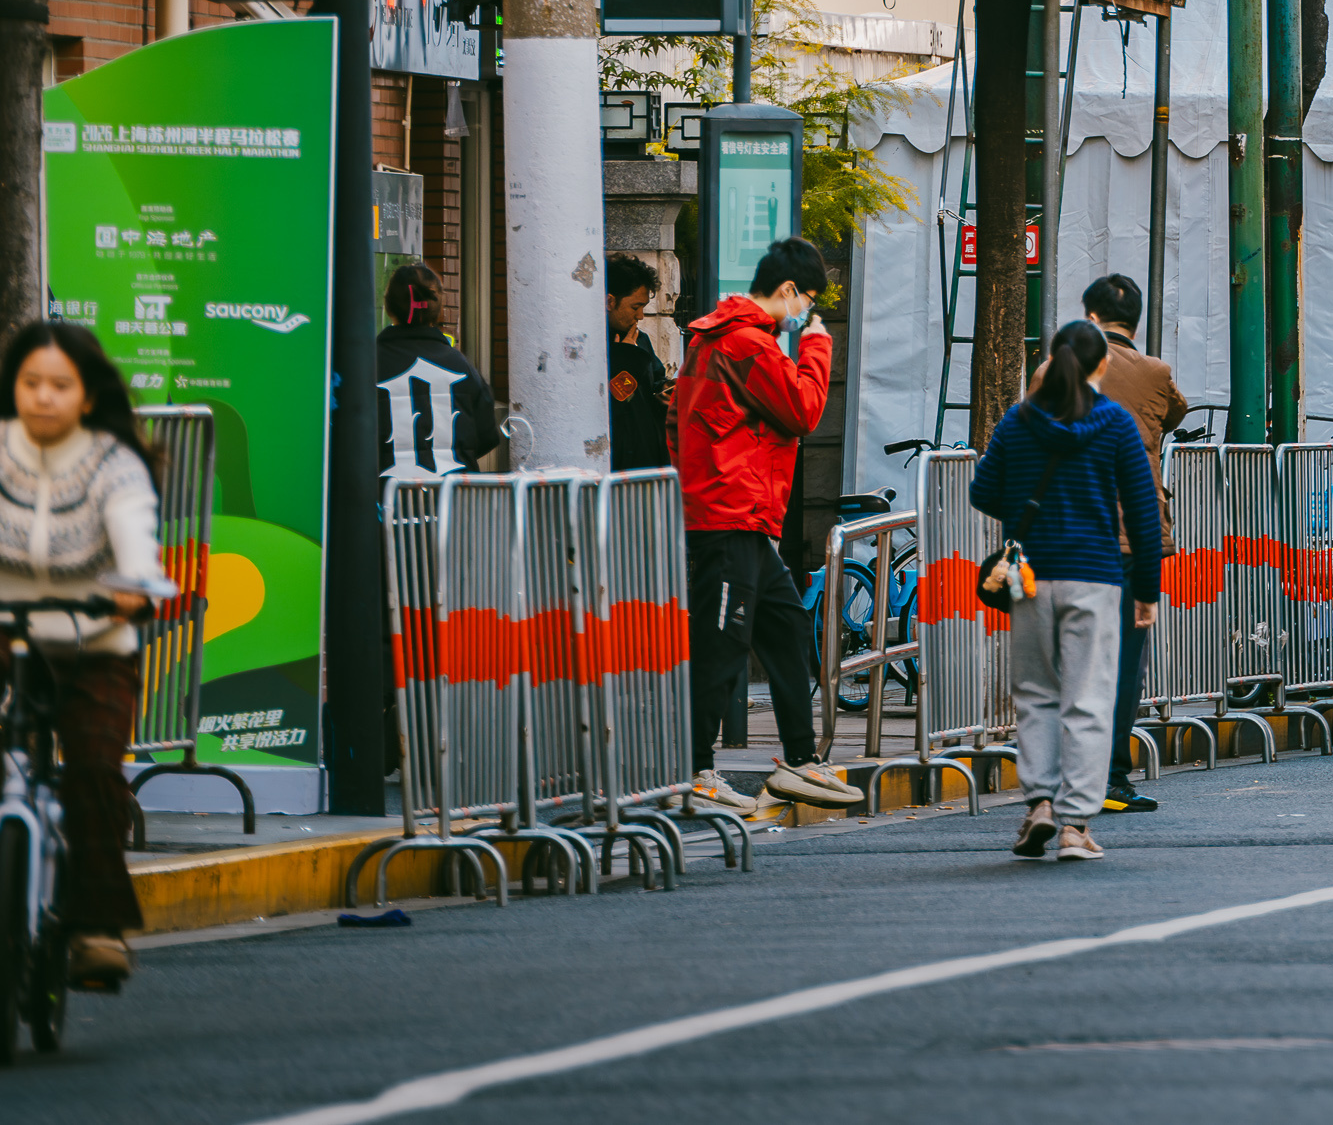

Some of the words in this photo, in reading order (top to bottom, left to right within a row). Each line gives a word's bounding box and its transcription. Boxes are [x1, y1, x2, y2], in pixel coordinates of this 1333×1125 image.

[82, 143, 135, 154] SHANGHAI
[137, 144, 178, 155] SUZHOU
[214, 147, 240, 157] HALF
[242, 148, 300, 159] MARATHON
[721, 141, 789, 155] 看信号灯走安全路
[49, 300, 98, 316] 海银行
[205, 303, 288, 322] saucony
[221, 728, 306, 752] 共享悦活力
